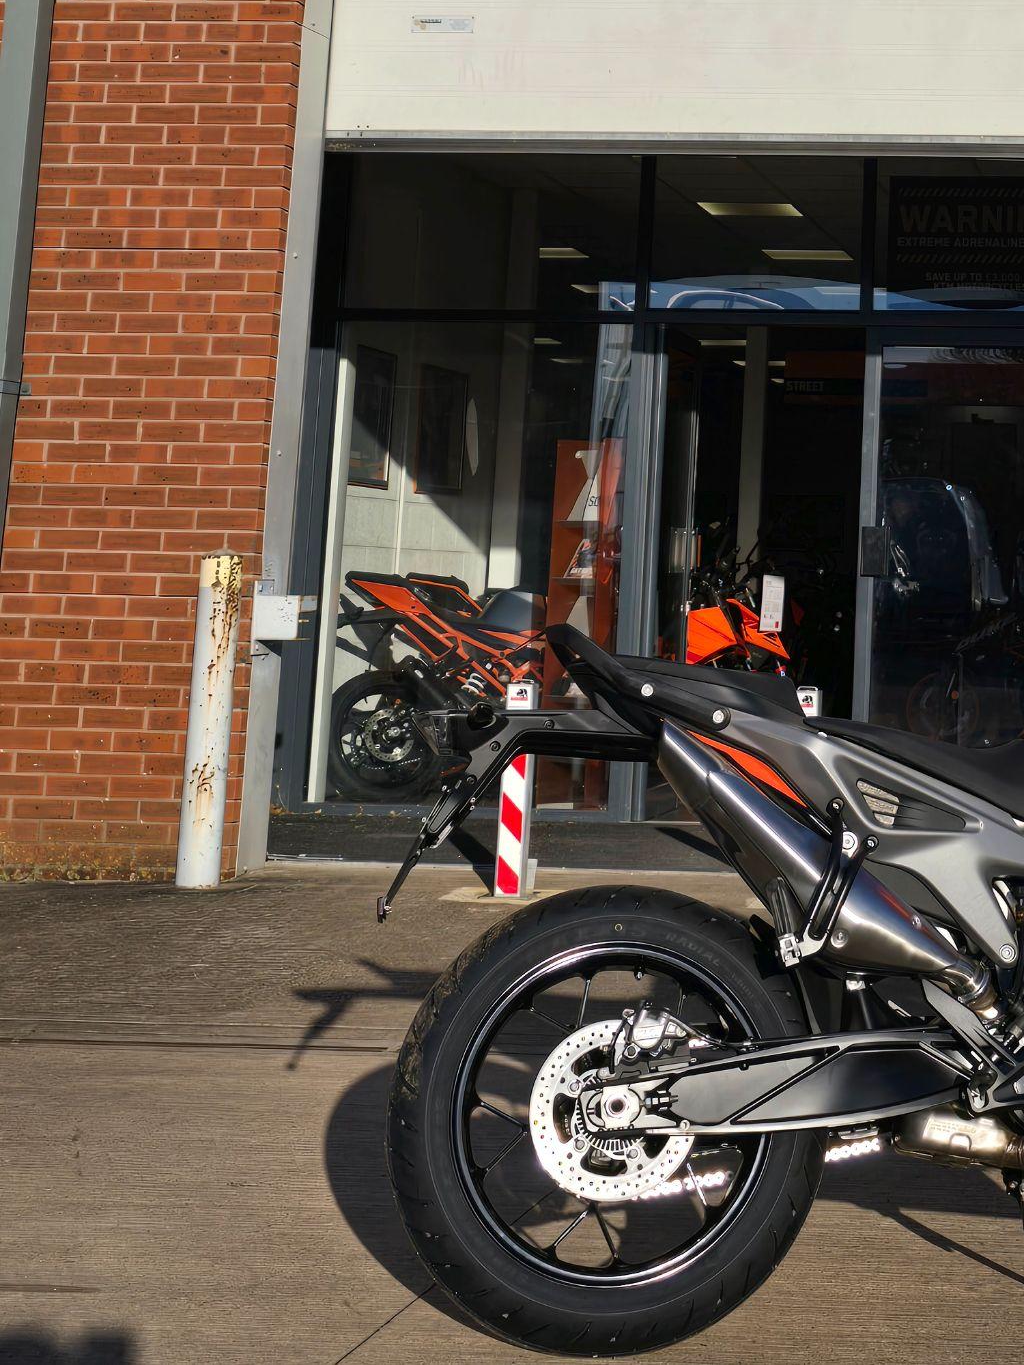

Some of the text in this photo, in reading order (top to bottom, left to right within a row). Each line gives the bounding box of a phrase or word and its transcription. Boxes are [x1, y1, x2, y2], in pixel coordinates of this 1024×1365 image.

[897, 237, 951, 247] EXTREME
[925, 272, 951, 281] SAVE
[785, 380, 825, 393] STREET
